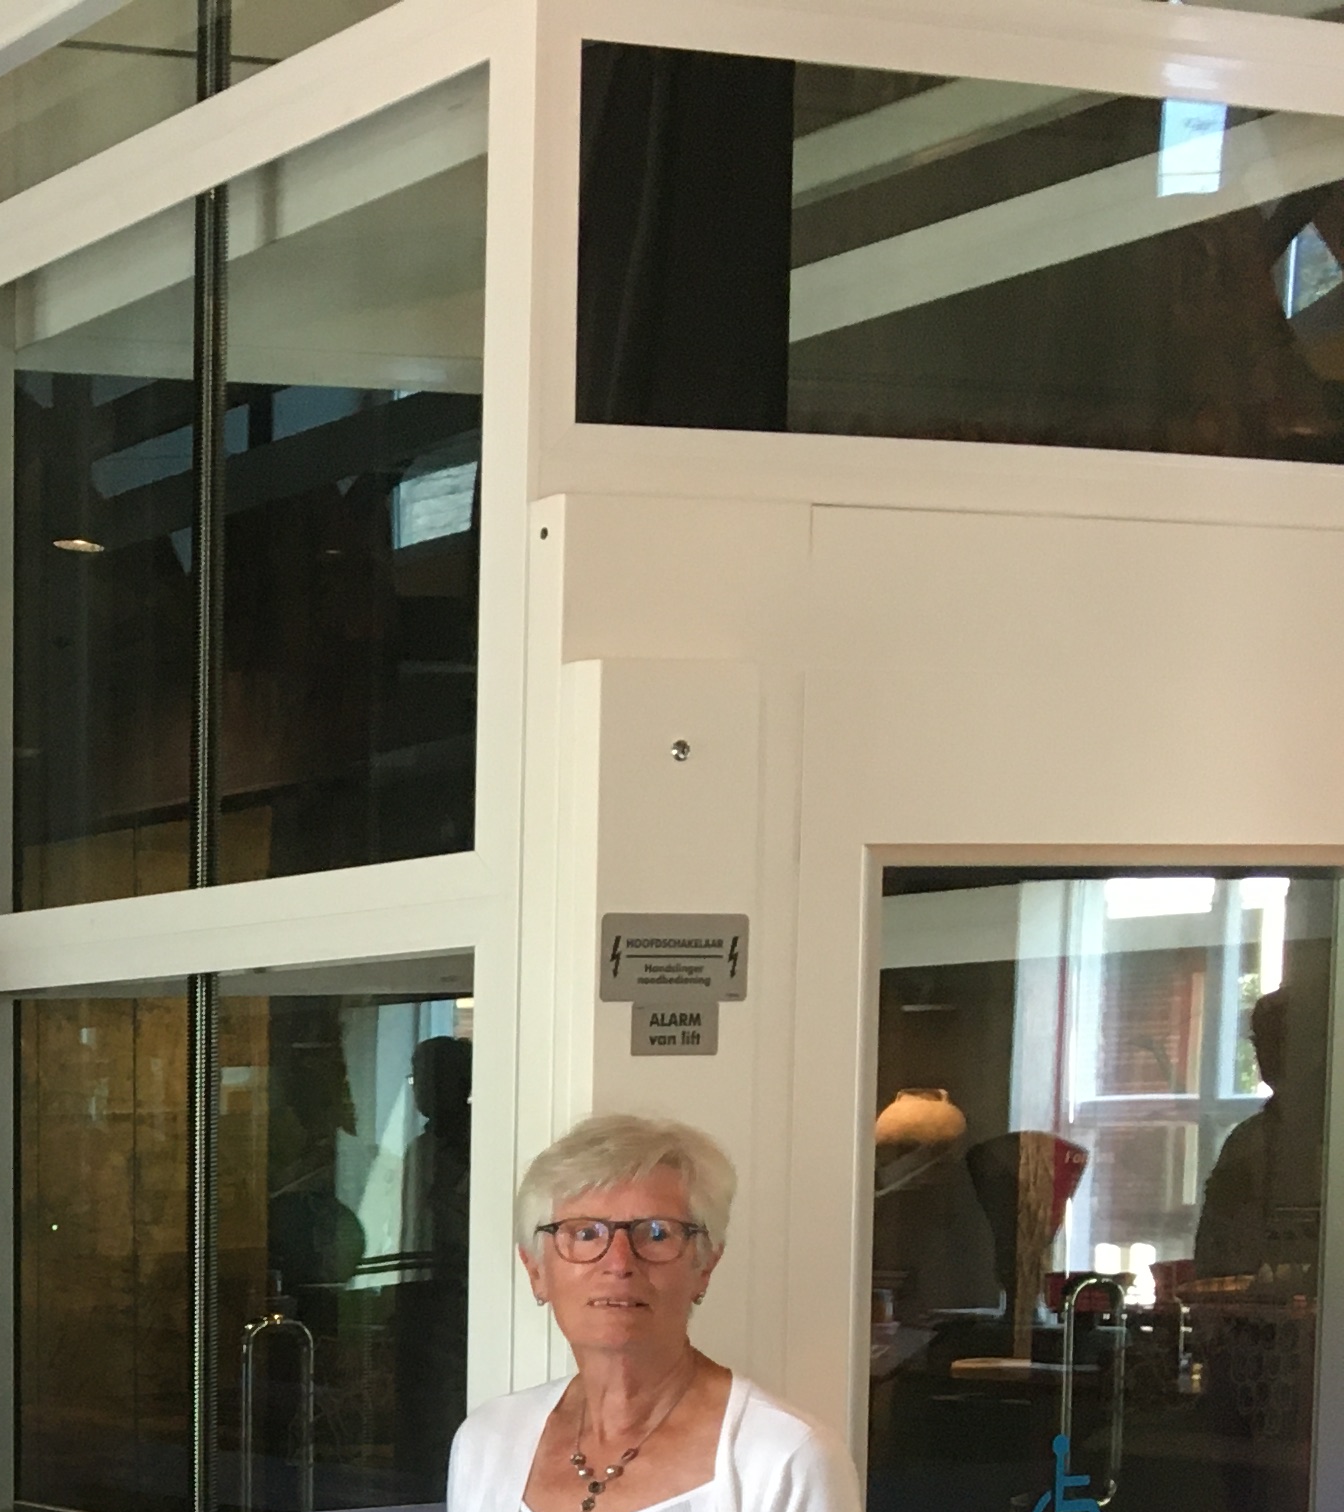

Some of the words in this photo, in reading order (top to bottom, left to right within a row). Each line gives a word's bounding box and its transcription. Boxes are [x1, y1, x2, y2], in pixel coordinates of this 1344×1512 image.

[625, 938, 724, 949] HOOFDSCHAKELAAR
[644, 963, 704, 975] Handslinger
[637, 974, 711, 987] noodbediening
[649, 1012, 702, 1027] ALARM
[648, 1034, 677, 1046] van
[681, 1030, 701, 1046] lift
